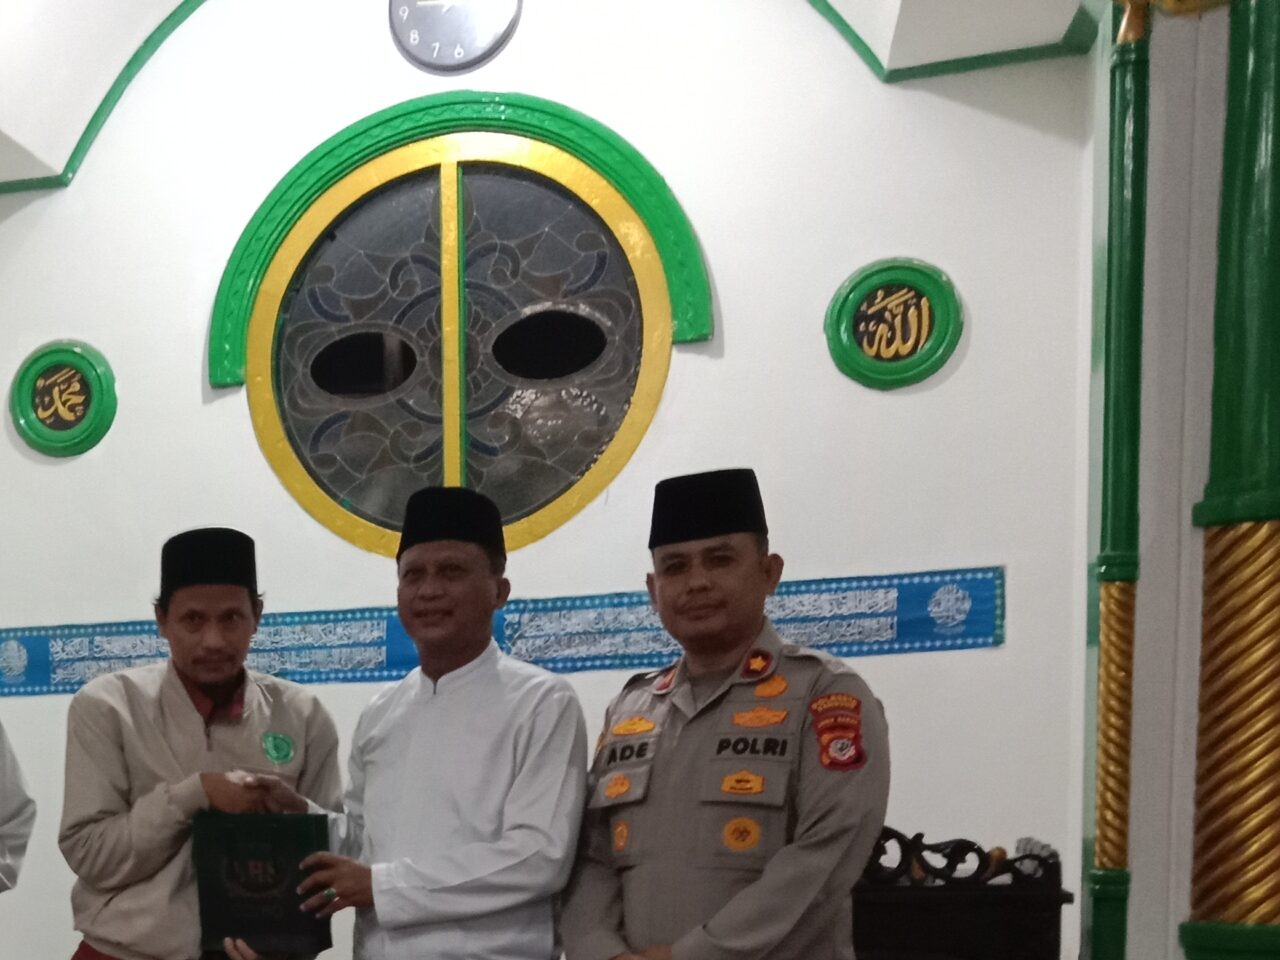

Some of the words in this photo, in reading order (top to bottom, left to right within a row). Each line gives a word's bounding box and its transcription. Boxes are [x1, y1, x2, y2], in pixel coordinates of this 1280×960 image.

[398, 6, 409, 23] 9
[409, 29, 420, 45] 8
[453, 44, 465, 59] 6
[607, 741, 649, 766] ADE
[716, 736, 788, 757] POLRI
